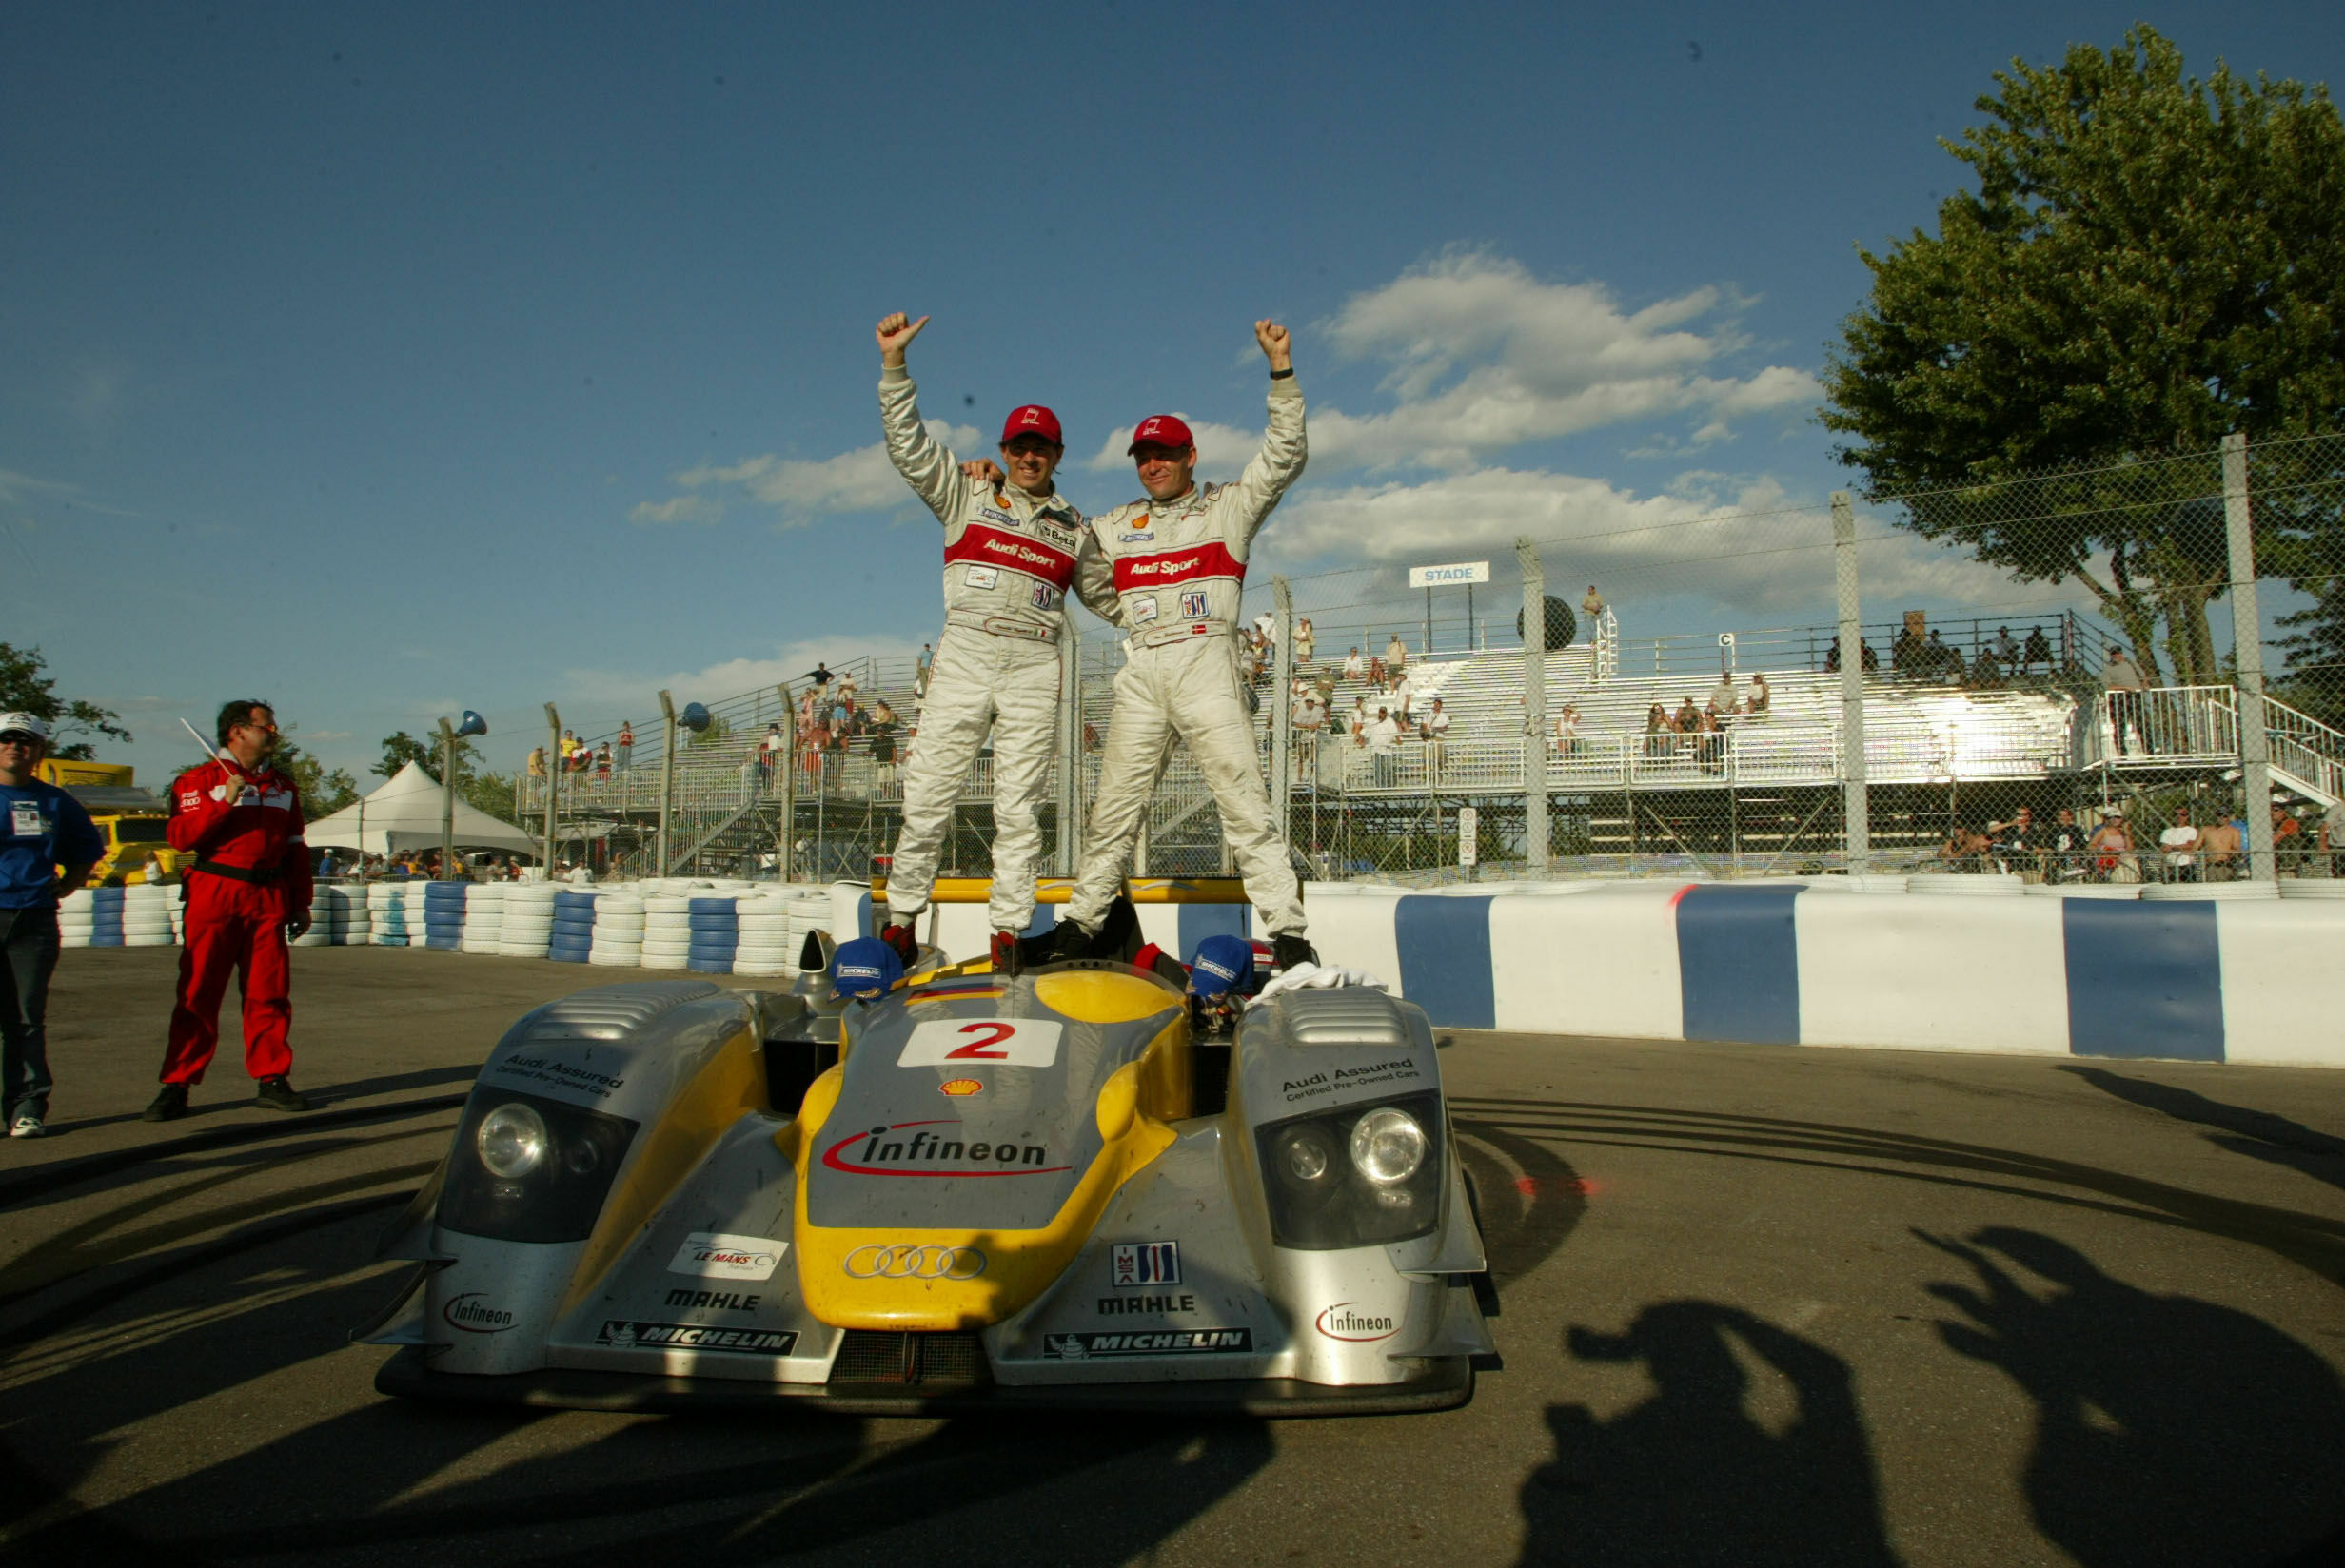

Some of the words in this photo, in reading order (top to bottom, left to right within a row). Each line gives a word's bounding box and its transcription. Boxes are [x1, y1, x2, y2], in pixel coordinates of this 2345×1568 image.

[984, 538, 1019, 556] Audi
[1017, 546, 1056, 569] Sport
[1130, 562, 1159, 575] Audi
[1160, 557, 1200, 575] Sport
[1425, 568, 1473, 581] STADE
[1721, 635, 1731, 645] C
[944, 1022, 1015, 1059] 2
[504, 1054, 549, 1068] Audi
[547, 1062, 625, 1089] Assured
[1282, 1072, 1328, 1092] Audi
[1334, 1057, 1414, 1080] Assured
[588, 1085, 612, 1098] Cars
[1286, 1086, 1332, 1103] Certified
[1333, 1072, 1394, 1091] Pre-Owned
[1395, 1070, 1420, 1079] Cars
[693, 1251, 710, 1262] LE
[711, 1253, 751, 1264] MANS
[1117, 1246, 1135, 1284] IMSA
[664, 1288, 761, 1311] MAHLE
[1098, 1294, 1195, 1315] MAHLE
[640, 1326, 790, 1348] MICHELIN
[1091, 1331, 1243, 1351] MICHELIN
